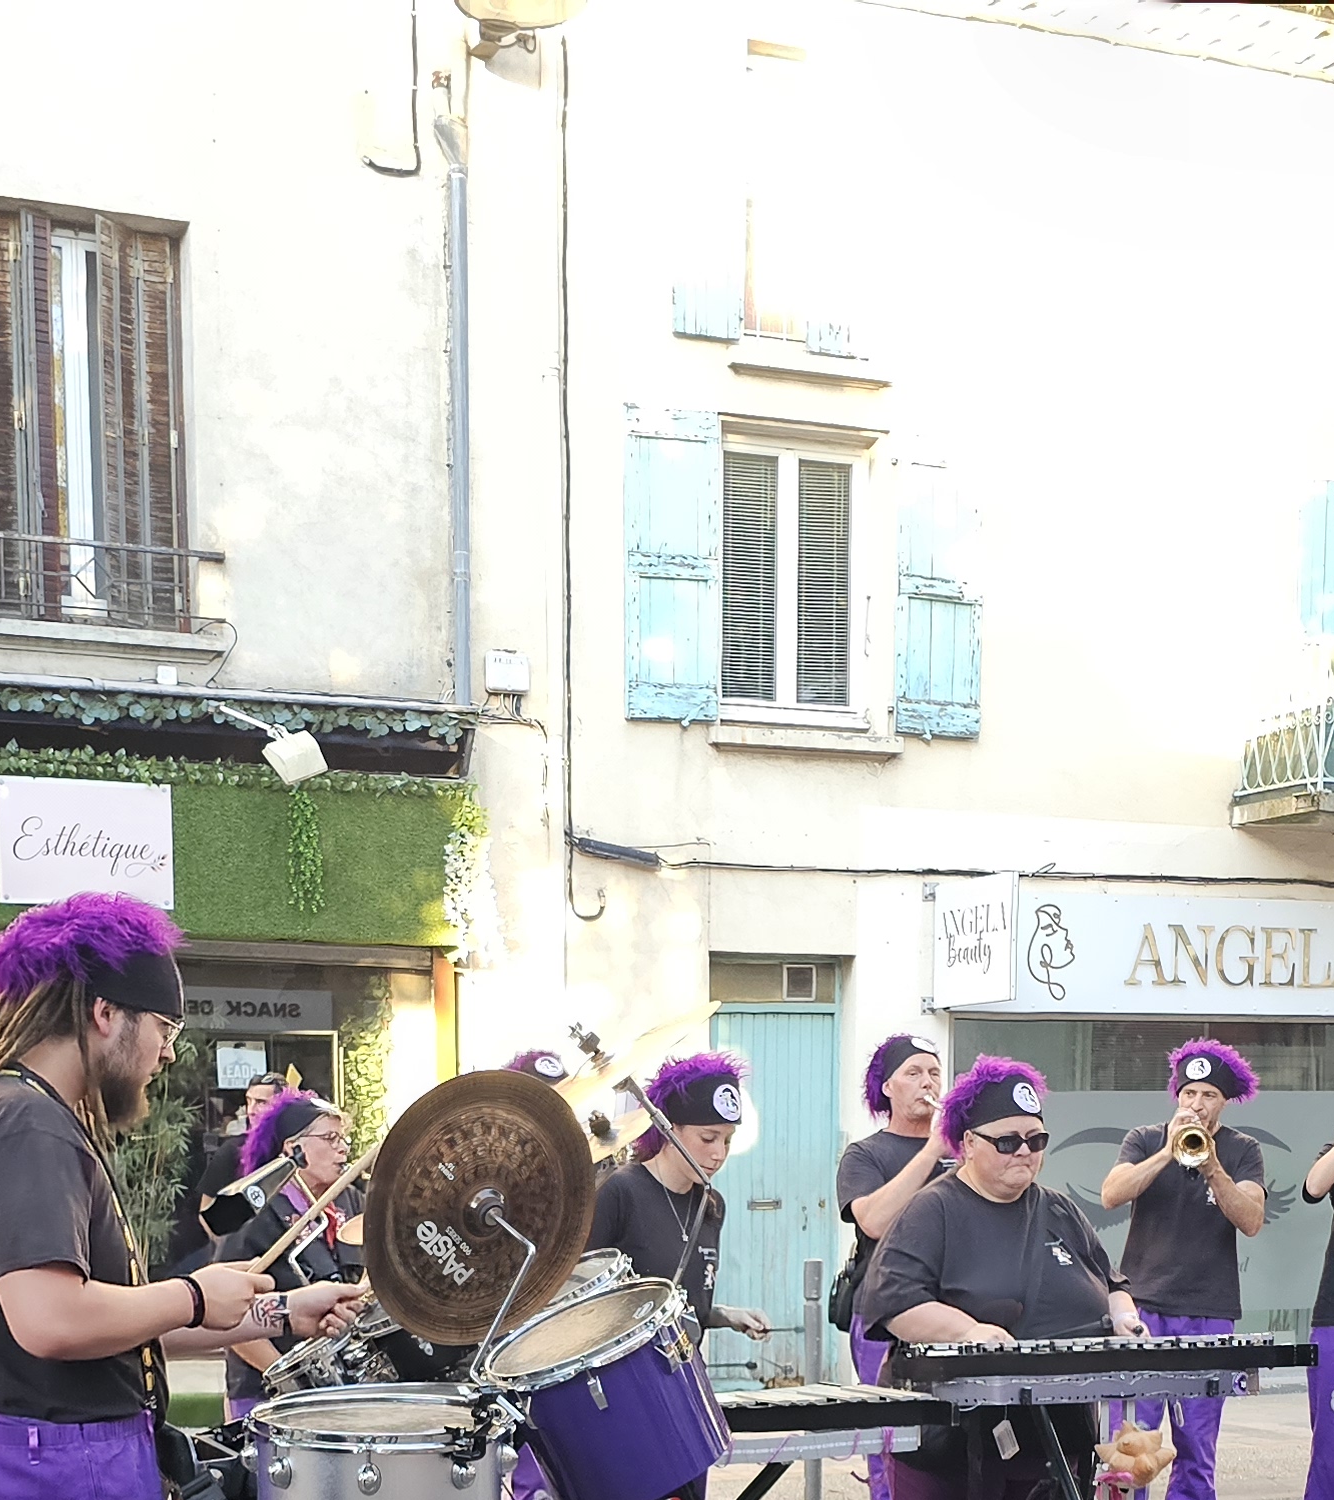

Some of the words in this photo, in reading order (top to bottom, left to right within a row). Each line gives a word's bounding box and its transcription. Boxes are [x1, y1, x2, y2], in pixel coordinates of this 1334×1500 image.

[12, 815, 154, 876] Esthétique
[938, 901, 1008, 940] ANGELA
[946, 930, 992, 975] Beauty
